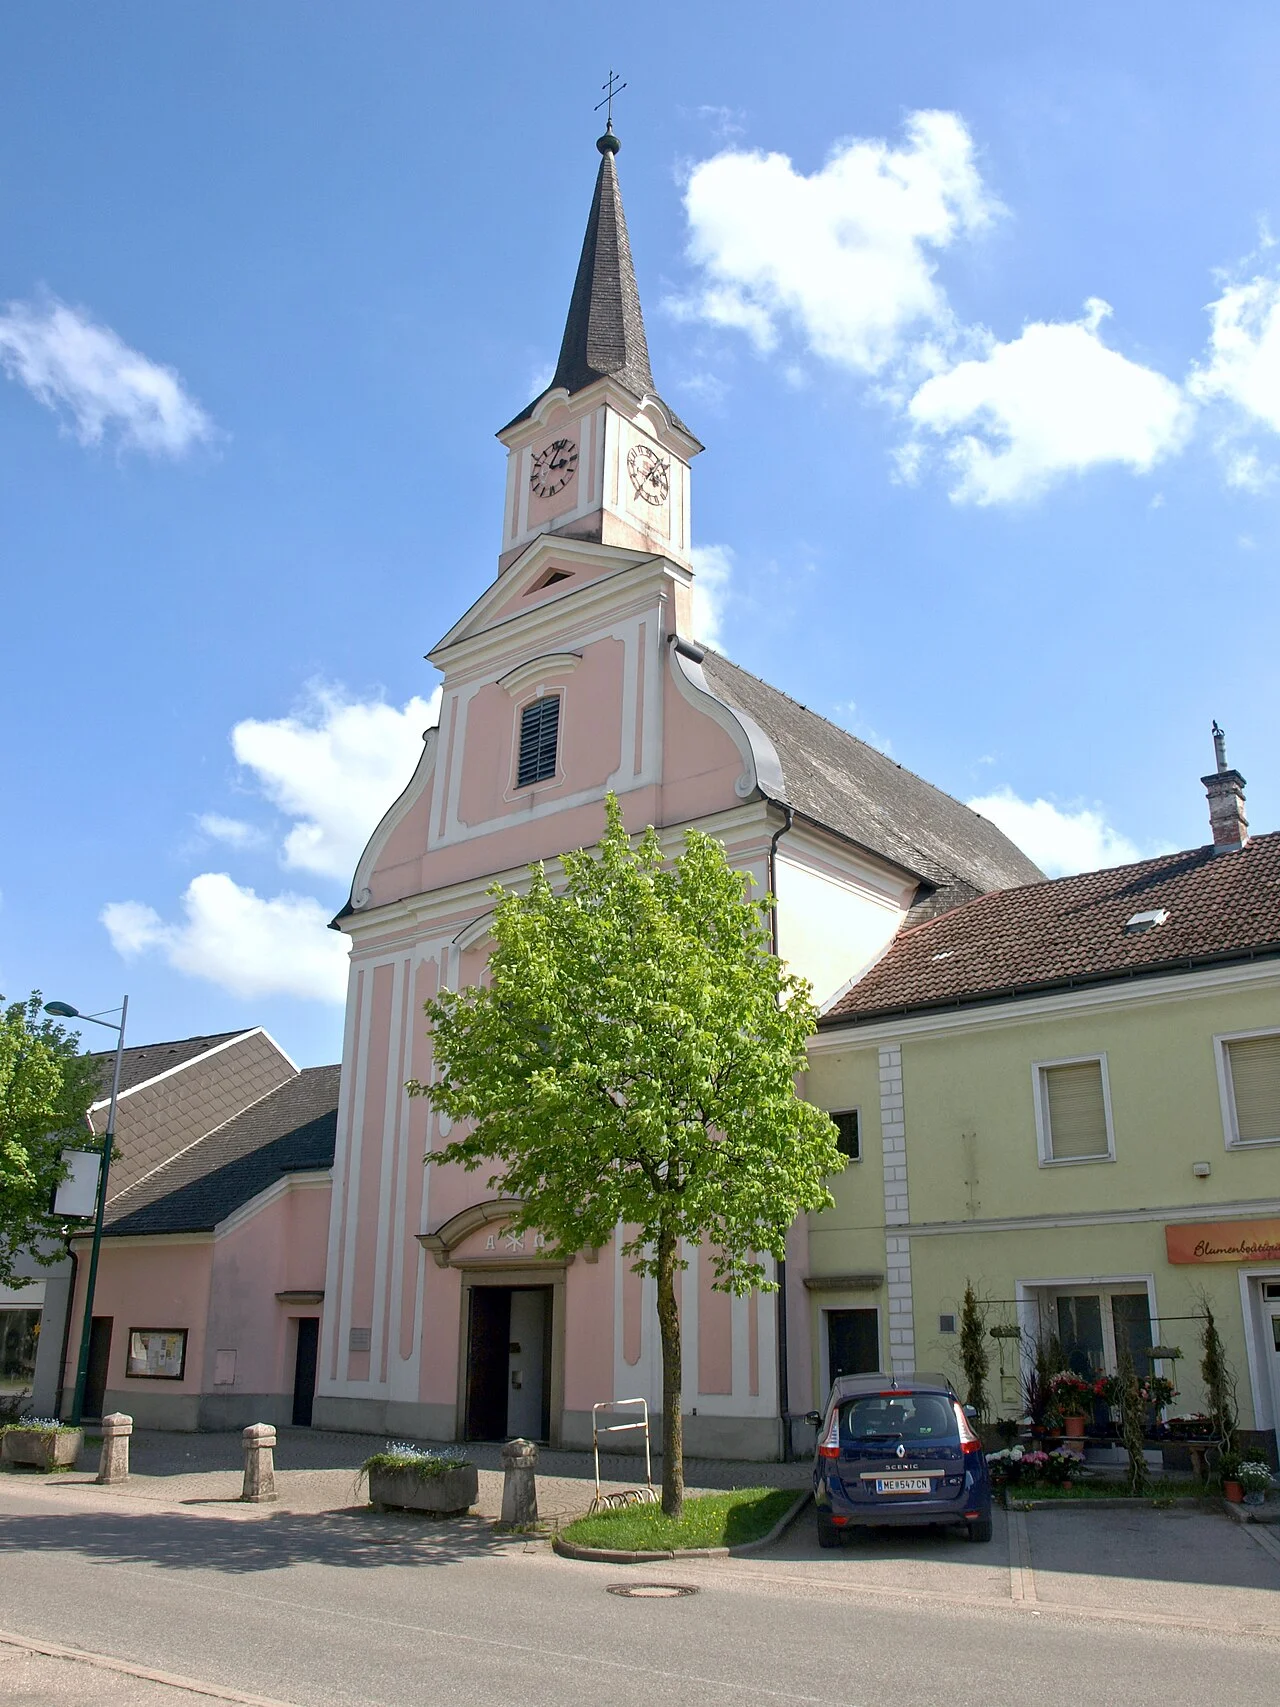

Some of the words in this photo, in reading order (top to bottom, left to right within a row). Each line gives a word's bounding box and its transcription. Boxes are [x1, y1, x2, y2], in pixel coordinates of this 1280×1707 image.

[883, 1480, 895, 1490] ME
[900, 1479, 915, 1489] 547
[916, 1479, 927, 1488] CN
